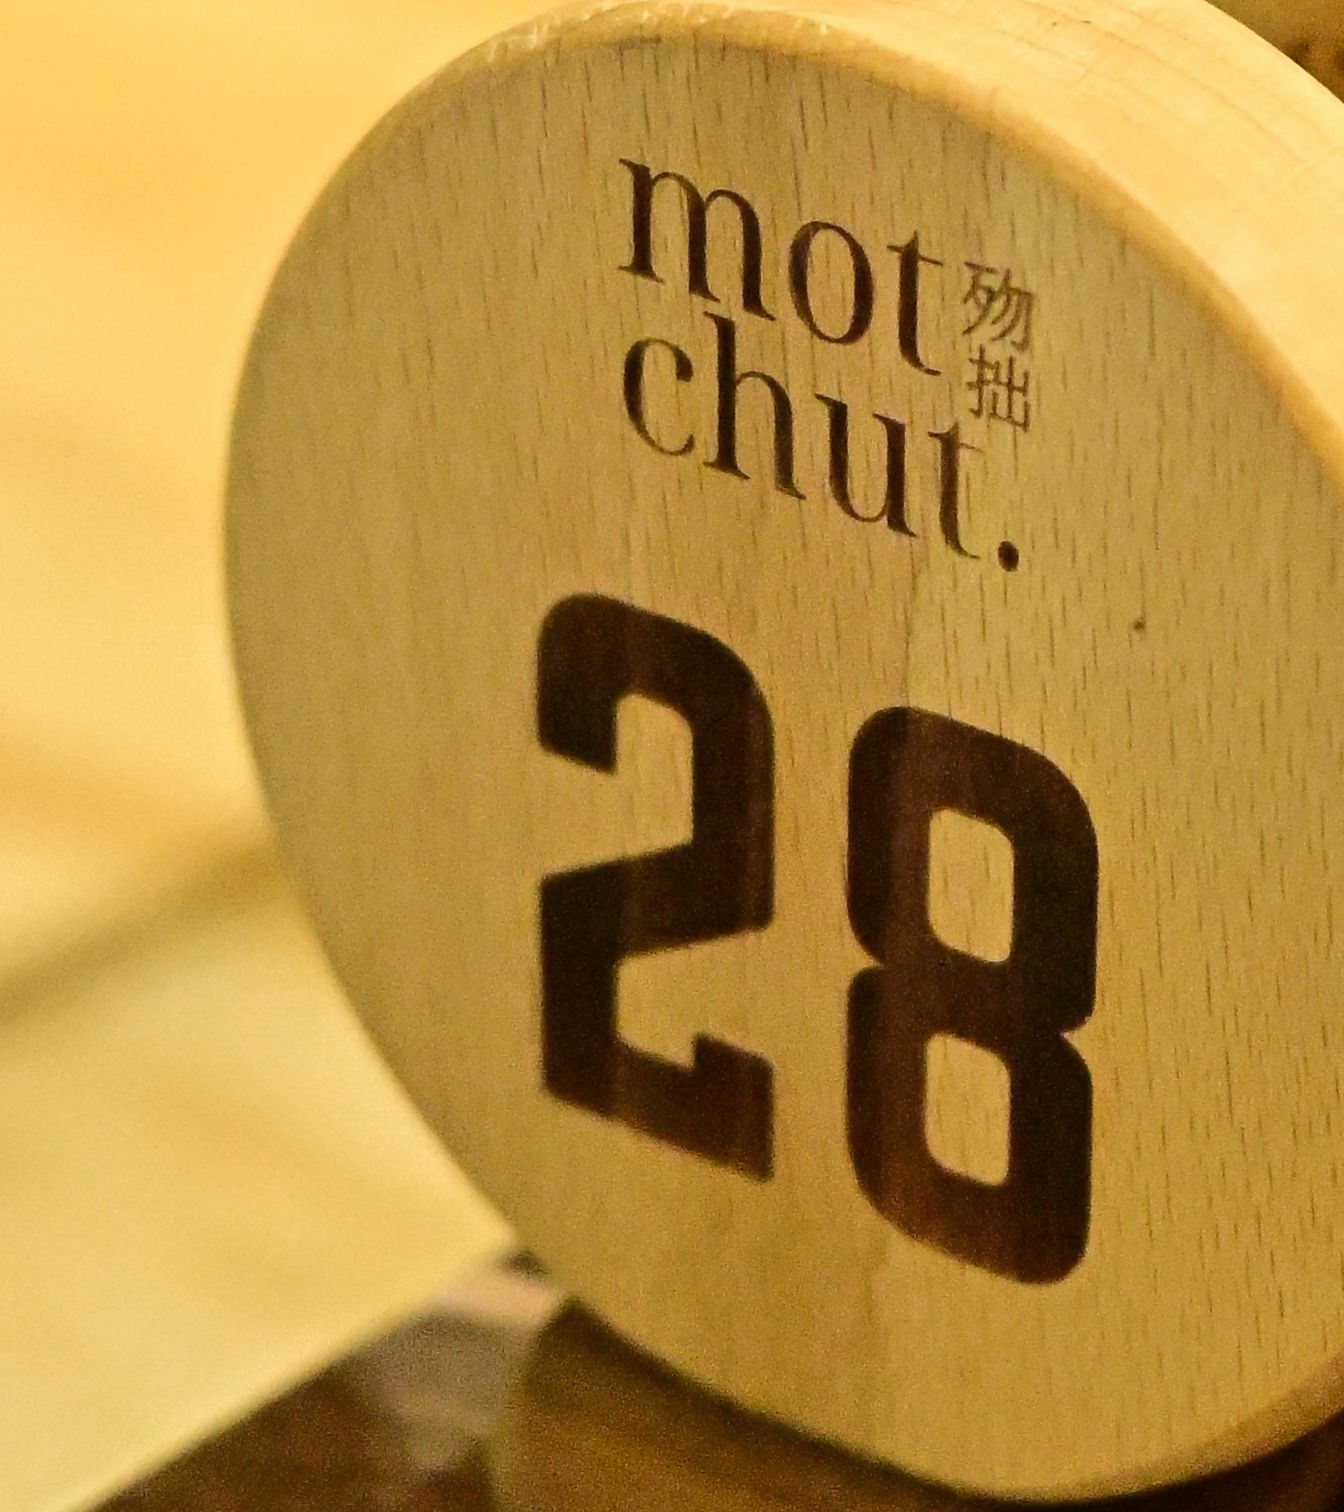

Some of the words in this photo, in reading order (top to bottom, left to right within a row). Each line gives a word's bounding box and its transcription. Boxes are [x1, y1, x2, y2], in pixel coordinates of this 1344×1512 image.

[617, 156, 946, 379] mot
[622, 311, 1022, 573] chut.
[535, 591, 1100, 1287] 28
